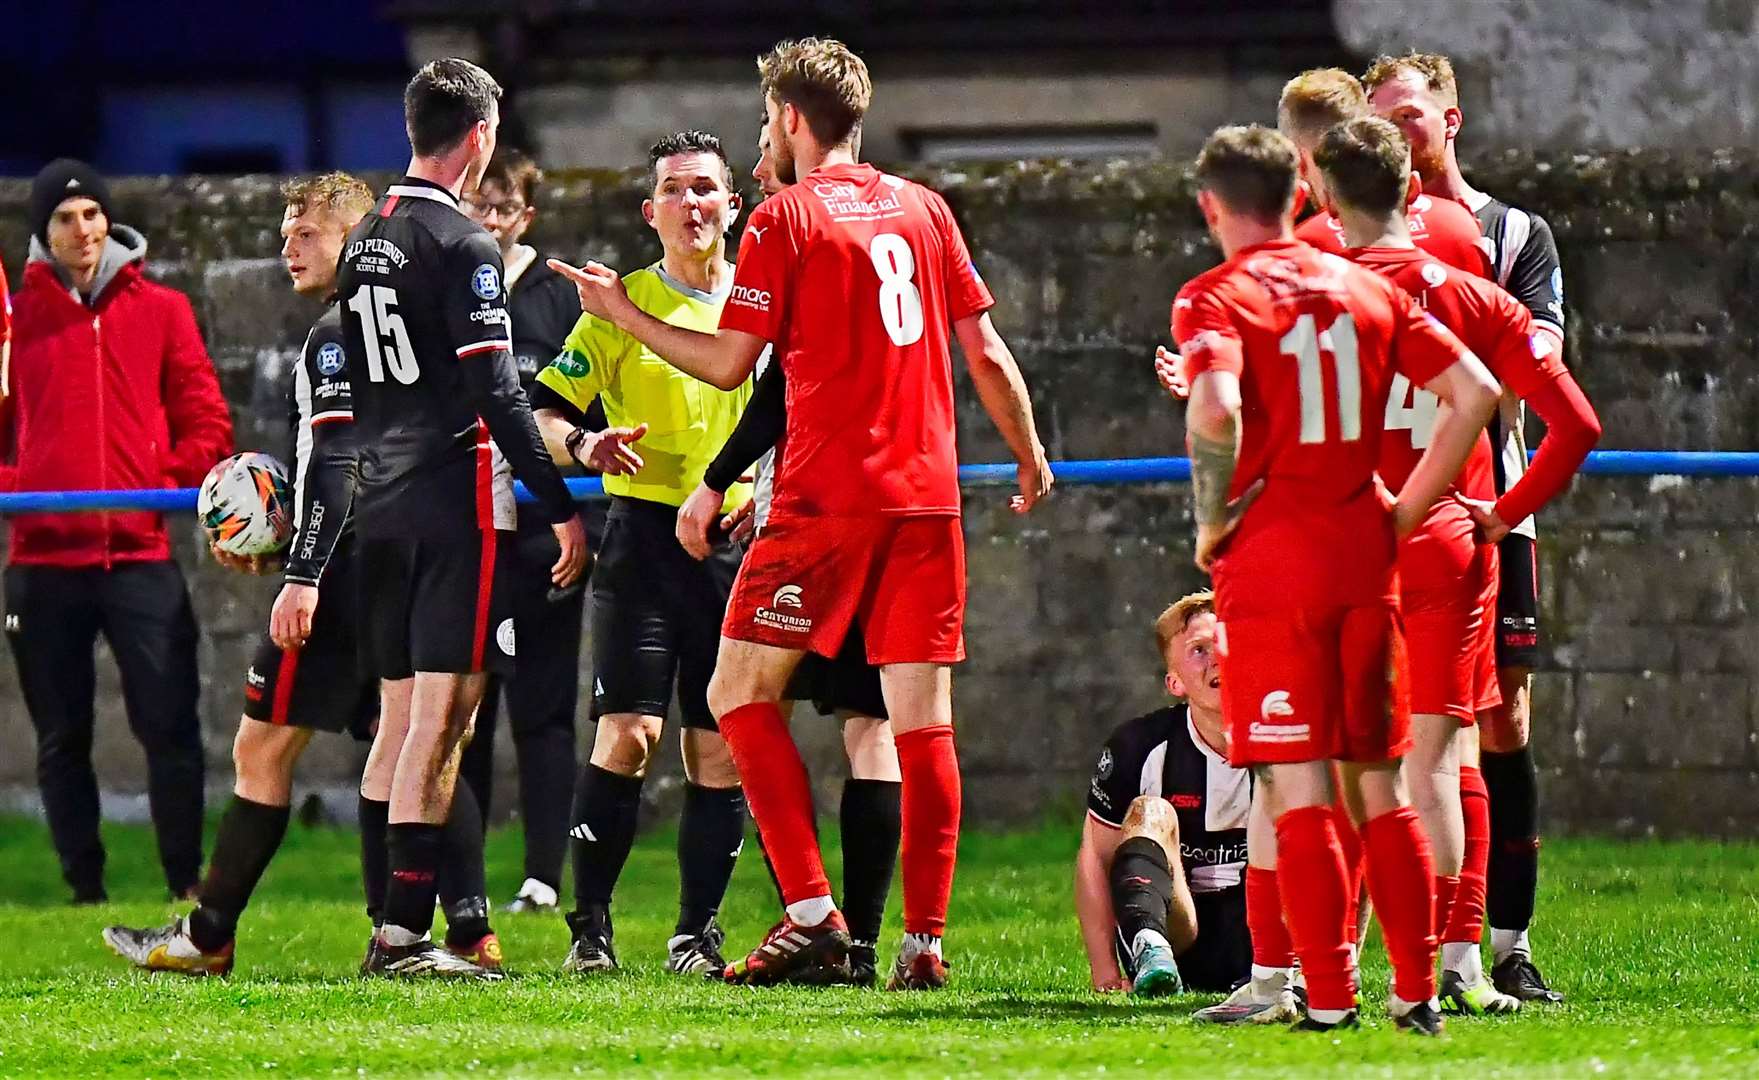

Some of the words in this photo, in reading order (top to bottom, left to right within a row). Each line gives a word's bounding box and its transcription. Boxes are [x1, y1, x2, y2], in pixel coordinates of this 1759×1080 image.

[822, 191, 901, 215] Financial
[348, 284, 421, 386] 15
[731, 284, 772, 305] mac
[870, 233, 925, 347] 8
[1279, 313, 1362, 444] 11
[1384, 371, 1439, 450] 4
